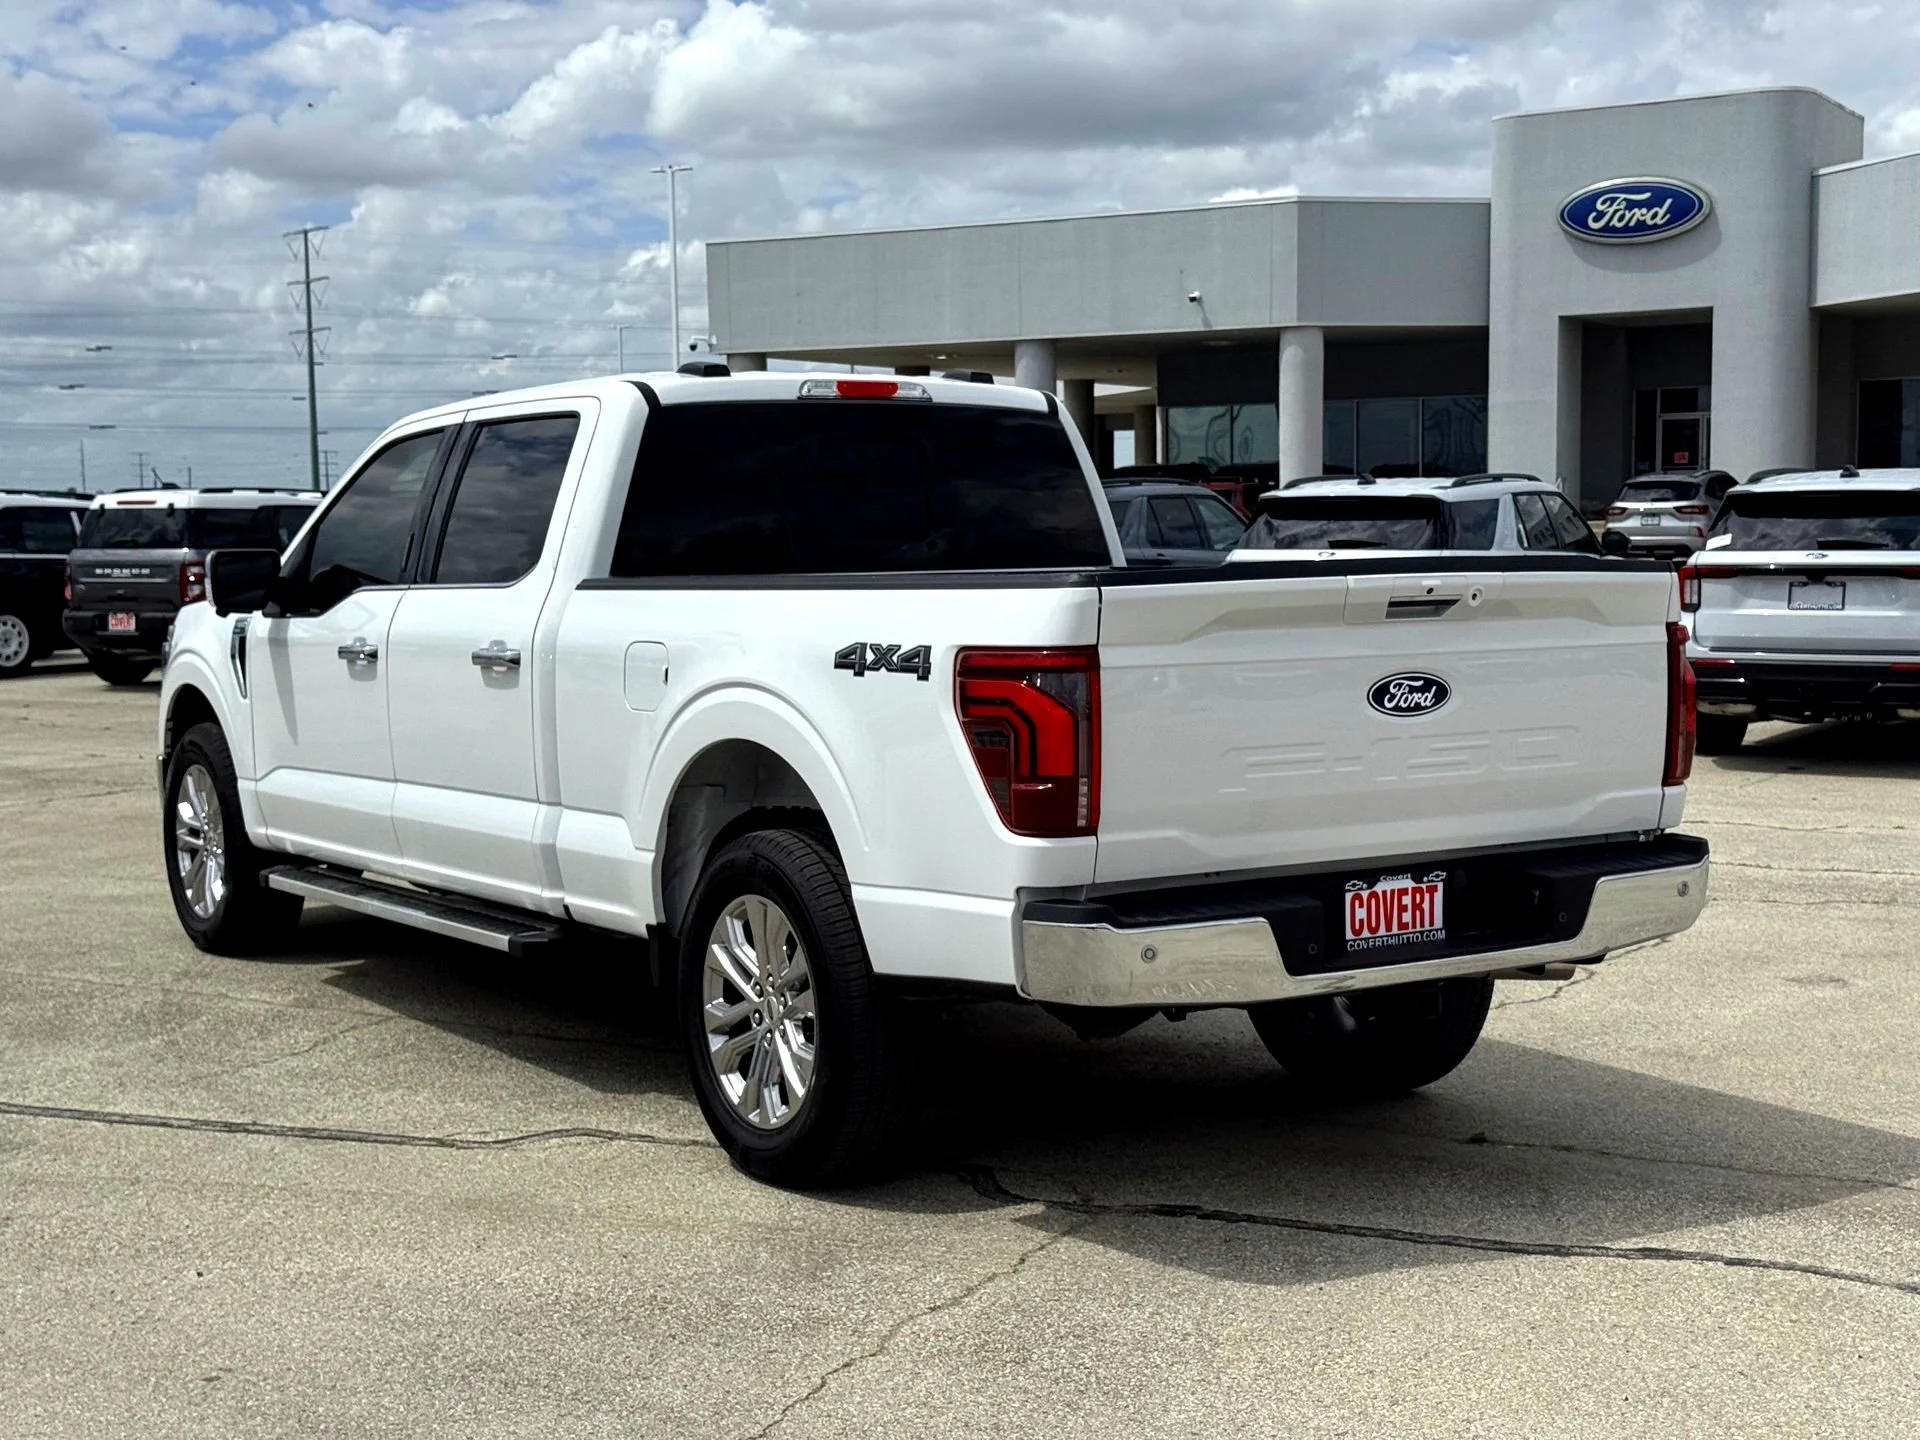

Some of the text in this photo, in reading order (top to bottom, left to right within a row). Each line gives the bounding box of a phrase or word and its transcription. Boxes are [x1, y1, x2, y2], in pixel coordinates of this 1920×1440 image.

[1587, 192, 1673, 230] Ford
[1384, 679, 1437, 708] Ford
[1380, 873, 1412, 882] Covert
[1350, 884, 1438, 937] COVERT
